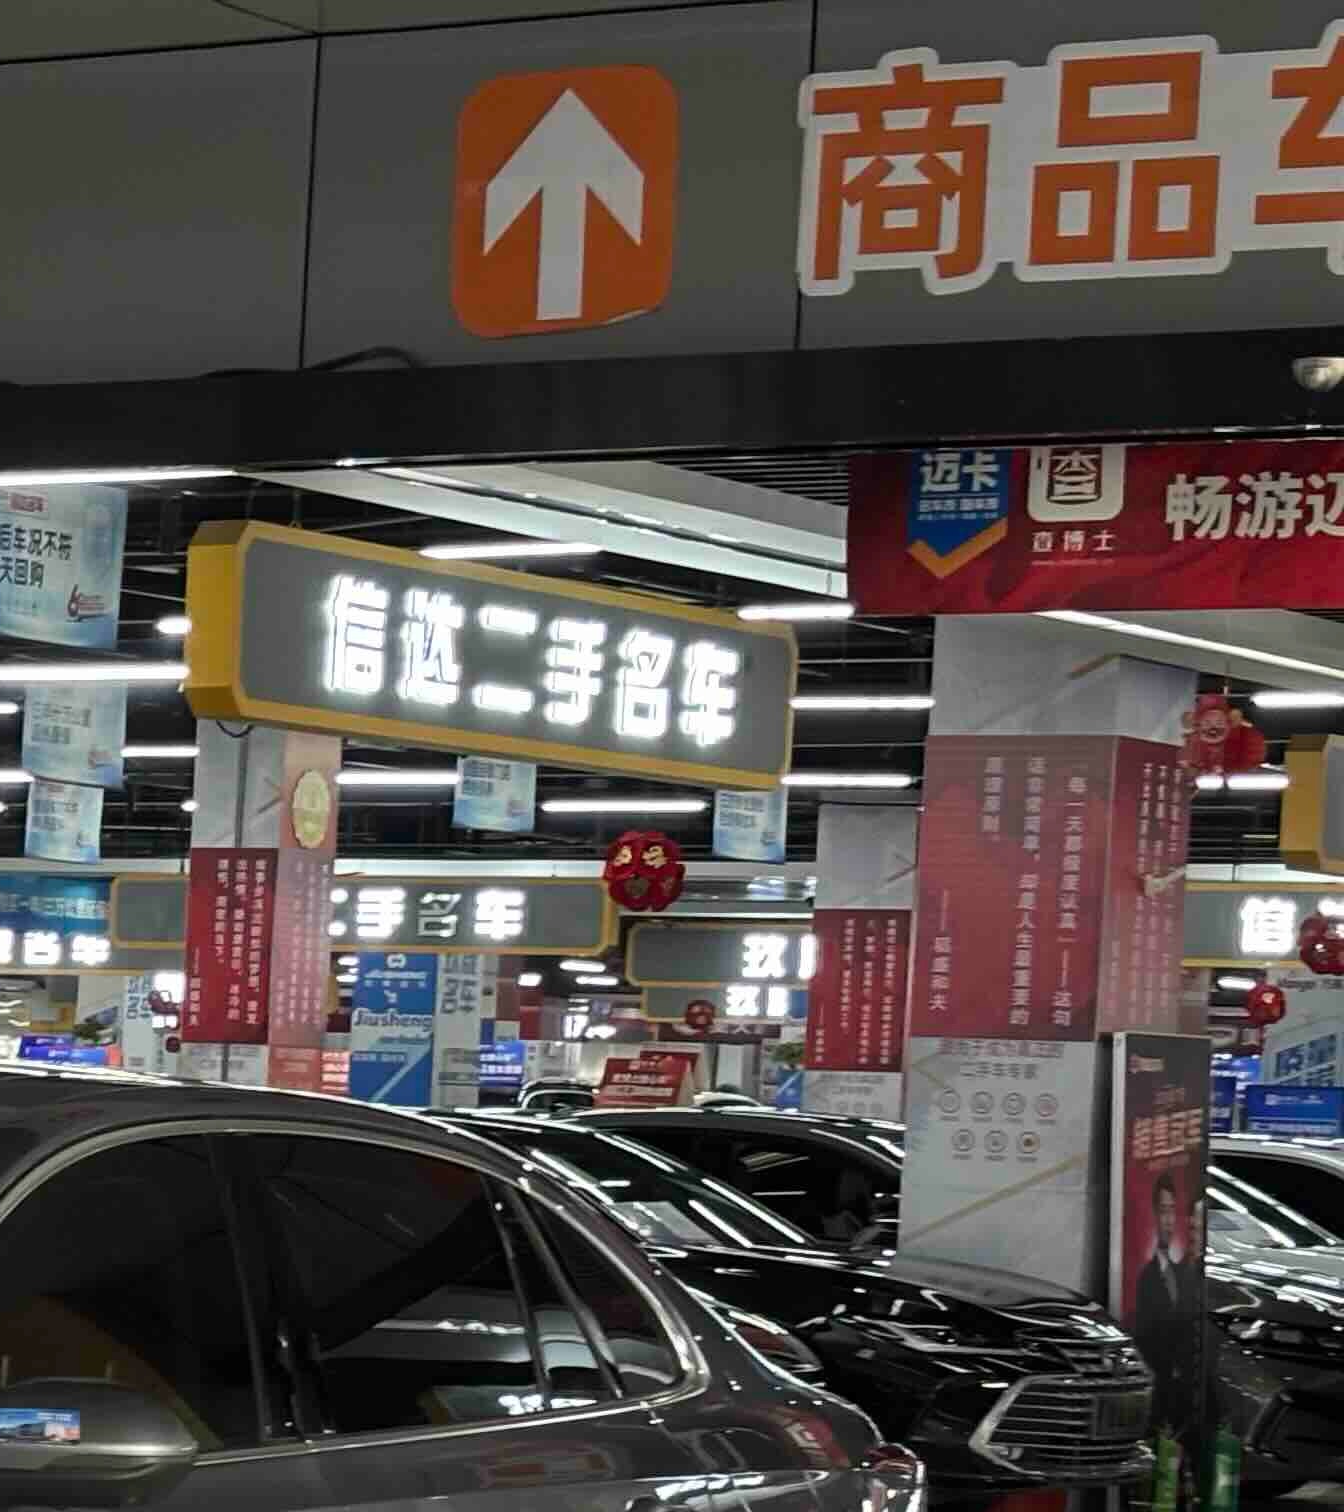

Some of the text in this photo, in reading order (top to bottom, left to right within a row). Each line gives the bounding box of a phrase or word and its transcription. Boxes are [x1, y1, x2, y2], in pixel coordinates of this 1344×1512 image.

[327, 572, 741, 748] 信达二手名车
